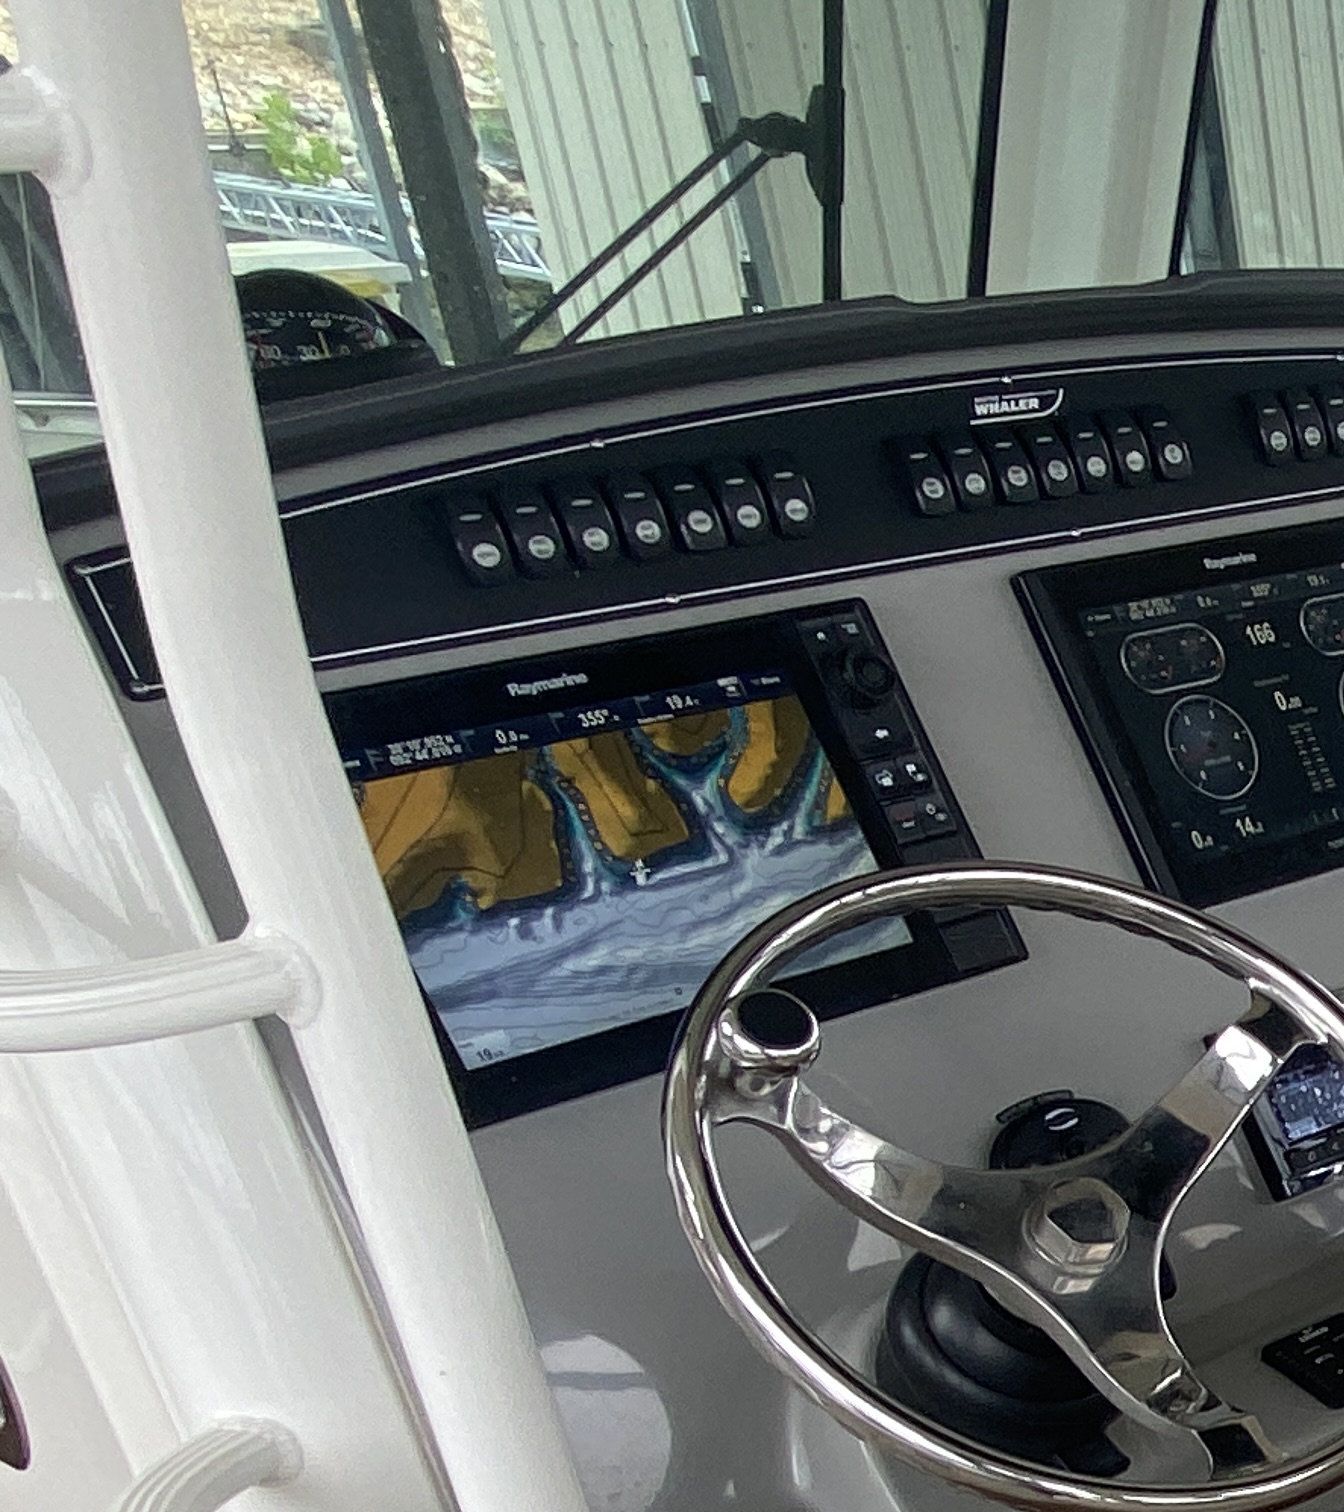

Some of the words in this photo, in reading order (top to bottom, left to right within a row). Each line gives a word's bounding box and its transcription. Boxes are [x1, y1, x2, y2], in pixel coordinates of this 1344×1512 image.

[974, 397, 1039, 416] WHALER
[1245, 620, 1275, 646] 166
[506, 672, 589, 697] Raymarine
